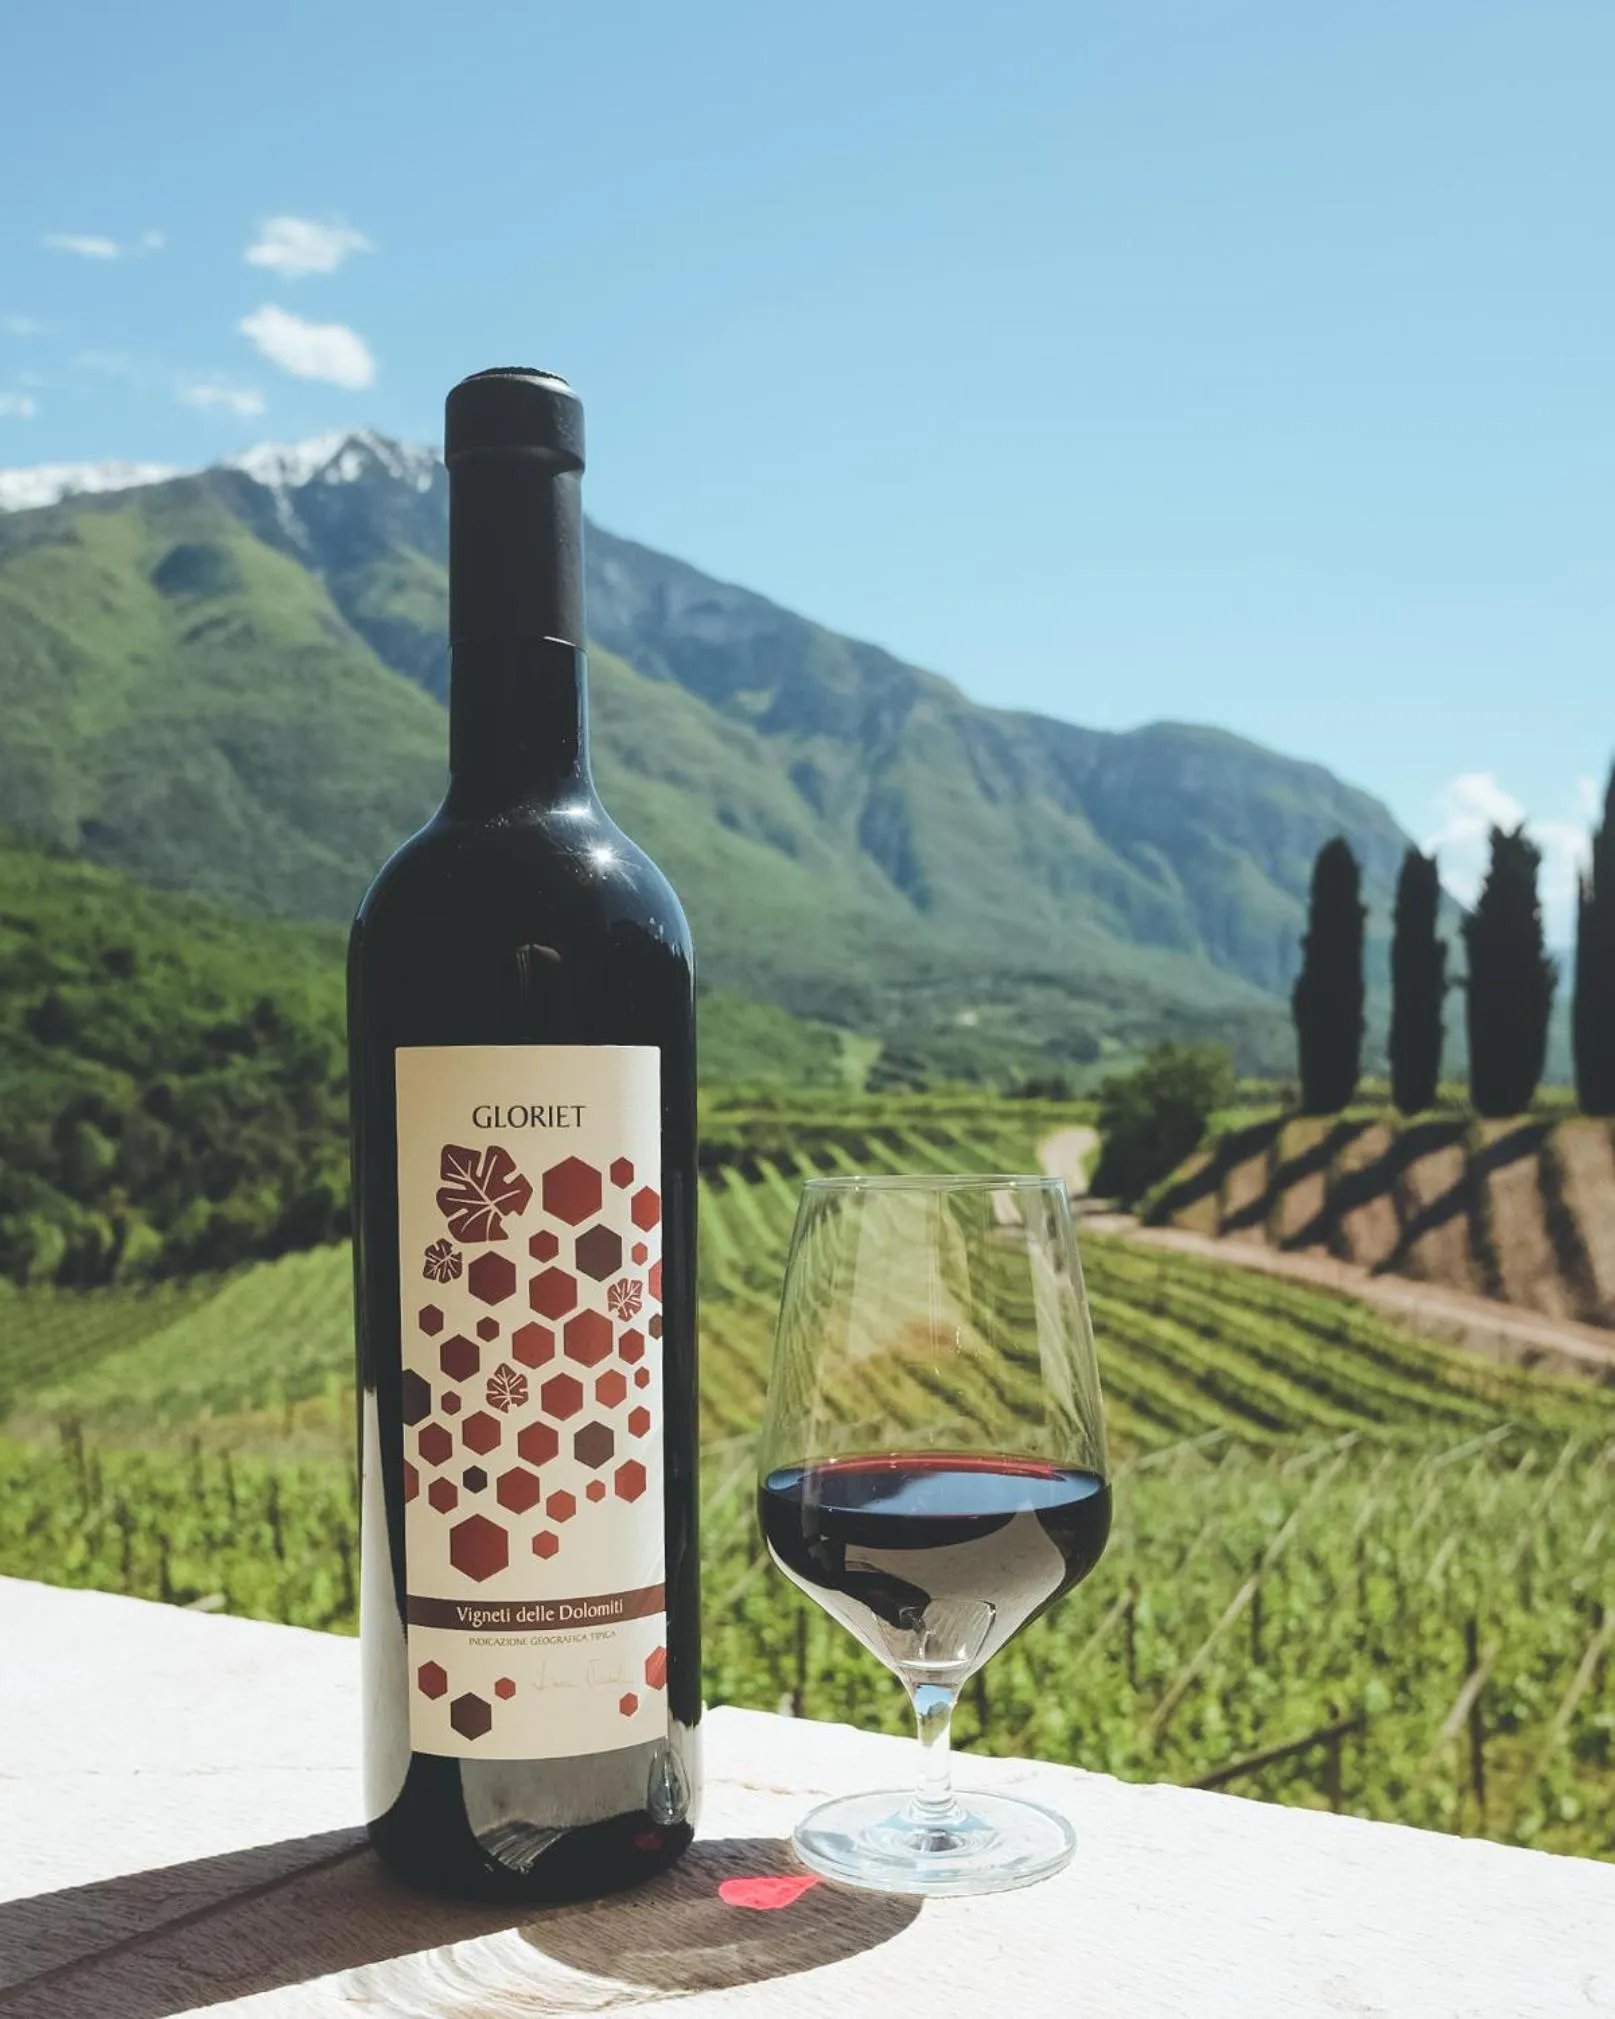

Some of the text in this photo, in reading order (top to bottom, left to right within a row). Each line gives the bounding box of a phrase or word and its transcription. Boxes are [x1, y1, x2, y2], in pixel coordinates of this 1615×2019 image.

[472, 1105, 586, 1129] GLORIET
[456, 1599, 623, 1628] Vigneti delle Dolomiti
[469, 1631, 616, 1646] INDICAZIONE GEOGRAFICA TIPICA
